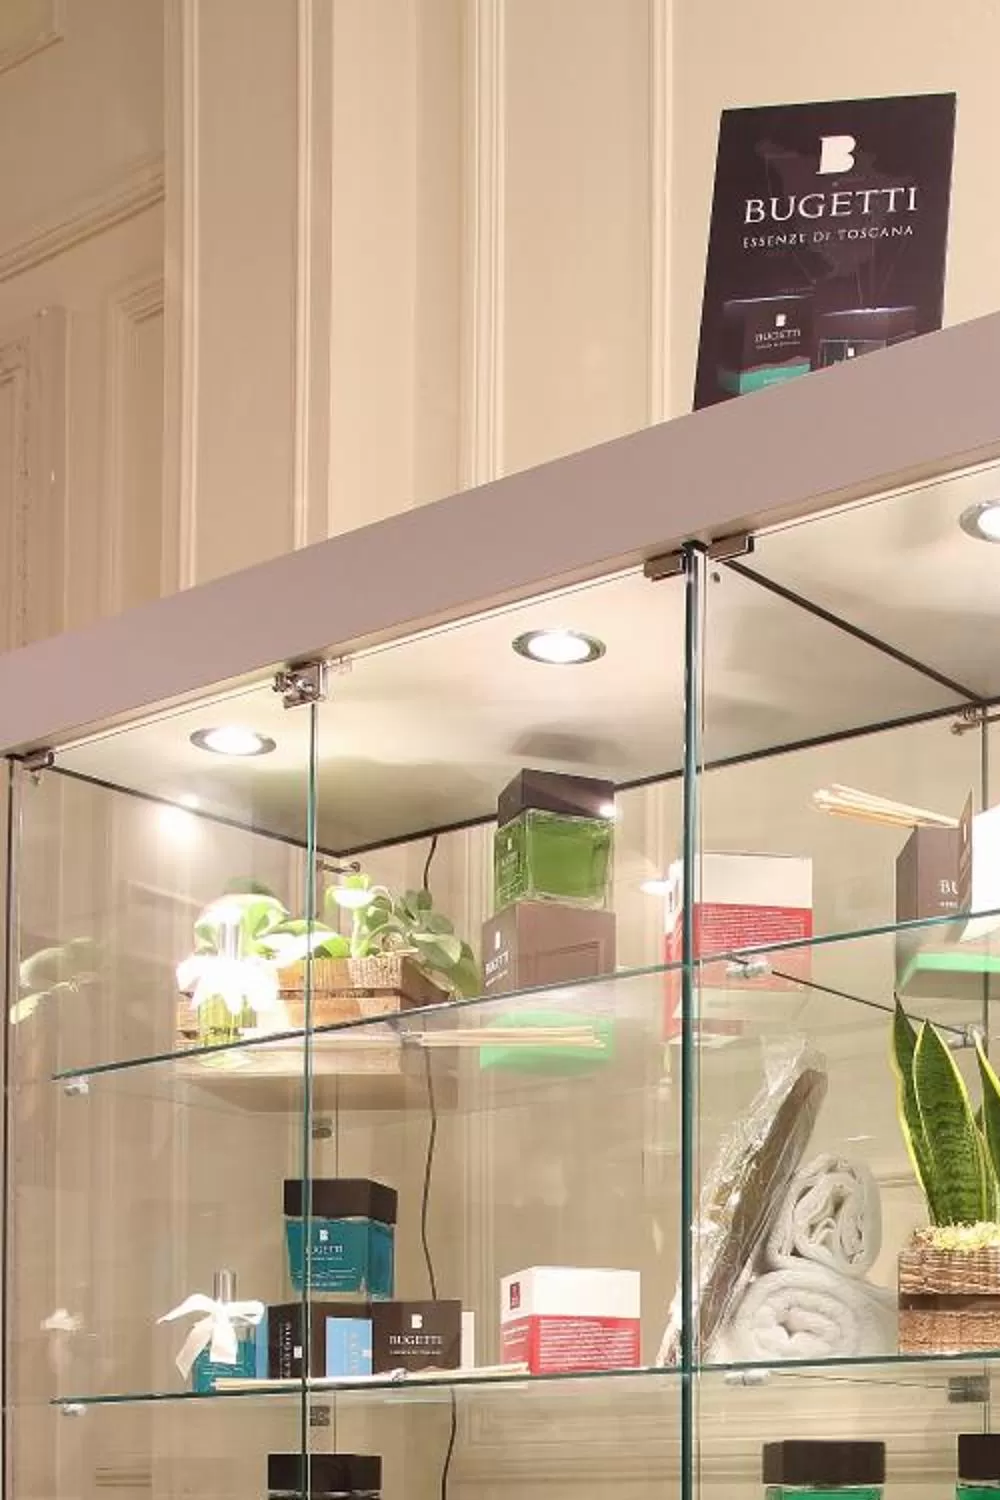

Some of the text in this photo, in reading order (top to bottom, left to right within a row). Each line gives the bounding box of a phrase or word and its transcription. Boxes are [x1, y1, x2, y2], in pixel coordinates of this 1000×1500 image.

[815, 134, 857, 175] B
[744, 187, 918, 225] BUGETTI
[743, 225, 914, 249] ESSENZE DI TOSCANA
